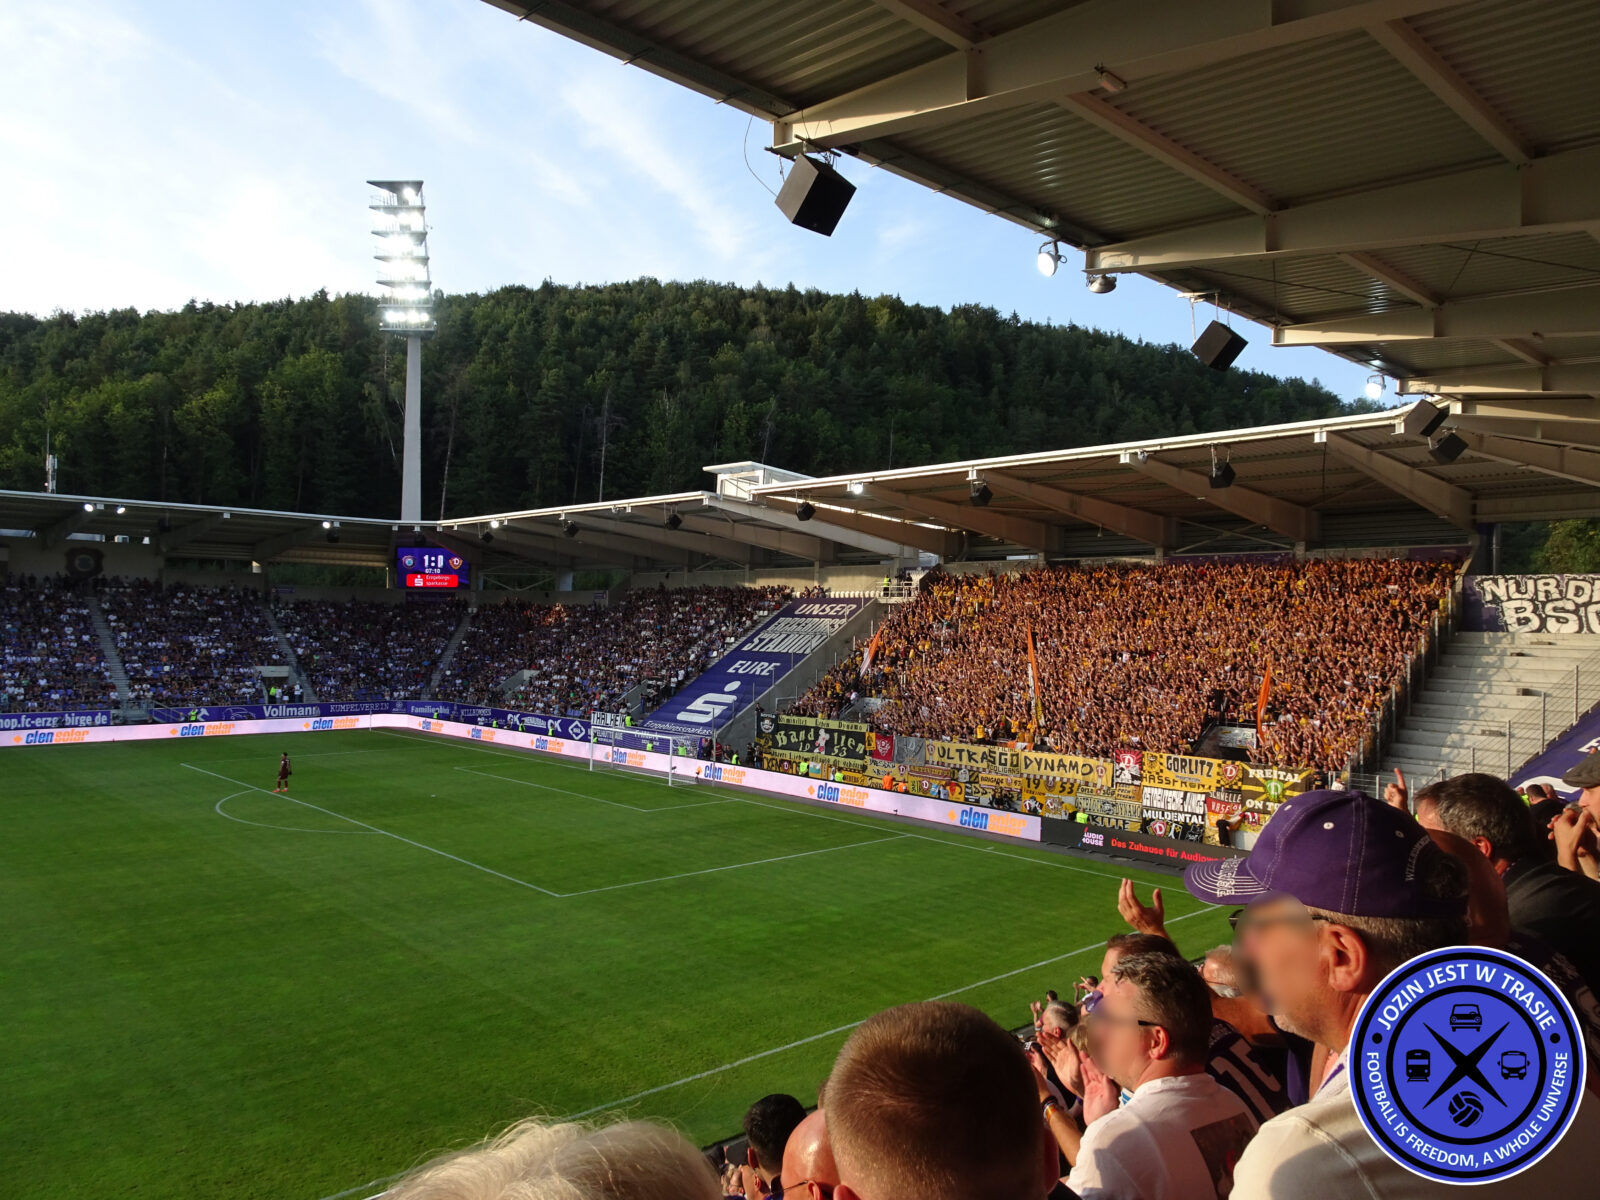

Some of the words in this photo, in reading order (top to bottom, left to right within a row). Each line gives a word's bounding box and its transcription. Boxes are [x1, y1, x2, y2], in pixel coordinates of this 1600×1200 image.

[1483, 578, 1600, 603] NURD
[794, 604, 857, 615] UNSER
[726, 661, 781, 676] EURE
[1024, 755, 1094, 776] DYNAMO
[1248, 769, 1302, 783] FREITAL
[1060, 782, 1074, 794] 53
[1246, 798, 1263, 809] ON
[1142, 808, 1204, 824] MULDENTAL
[1111, 838, 1128, 848] Das
[1128, 842, 1164, 855] Zuhause
[1166, 847, 1178, 857] für
